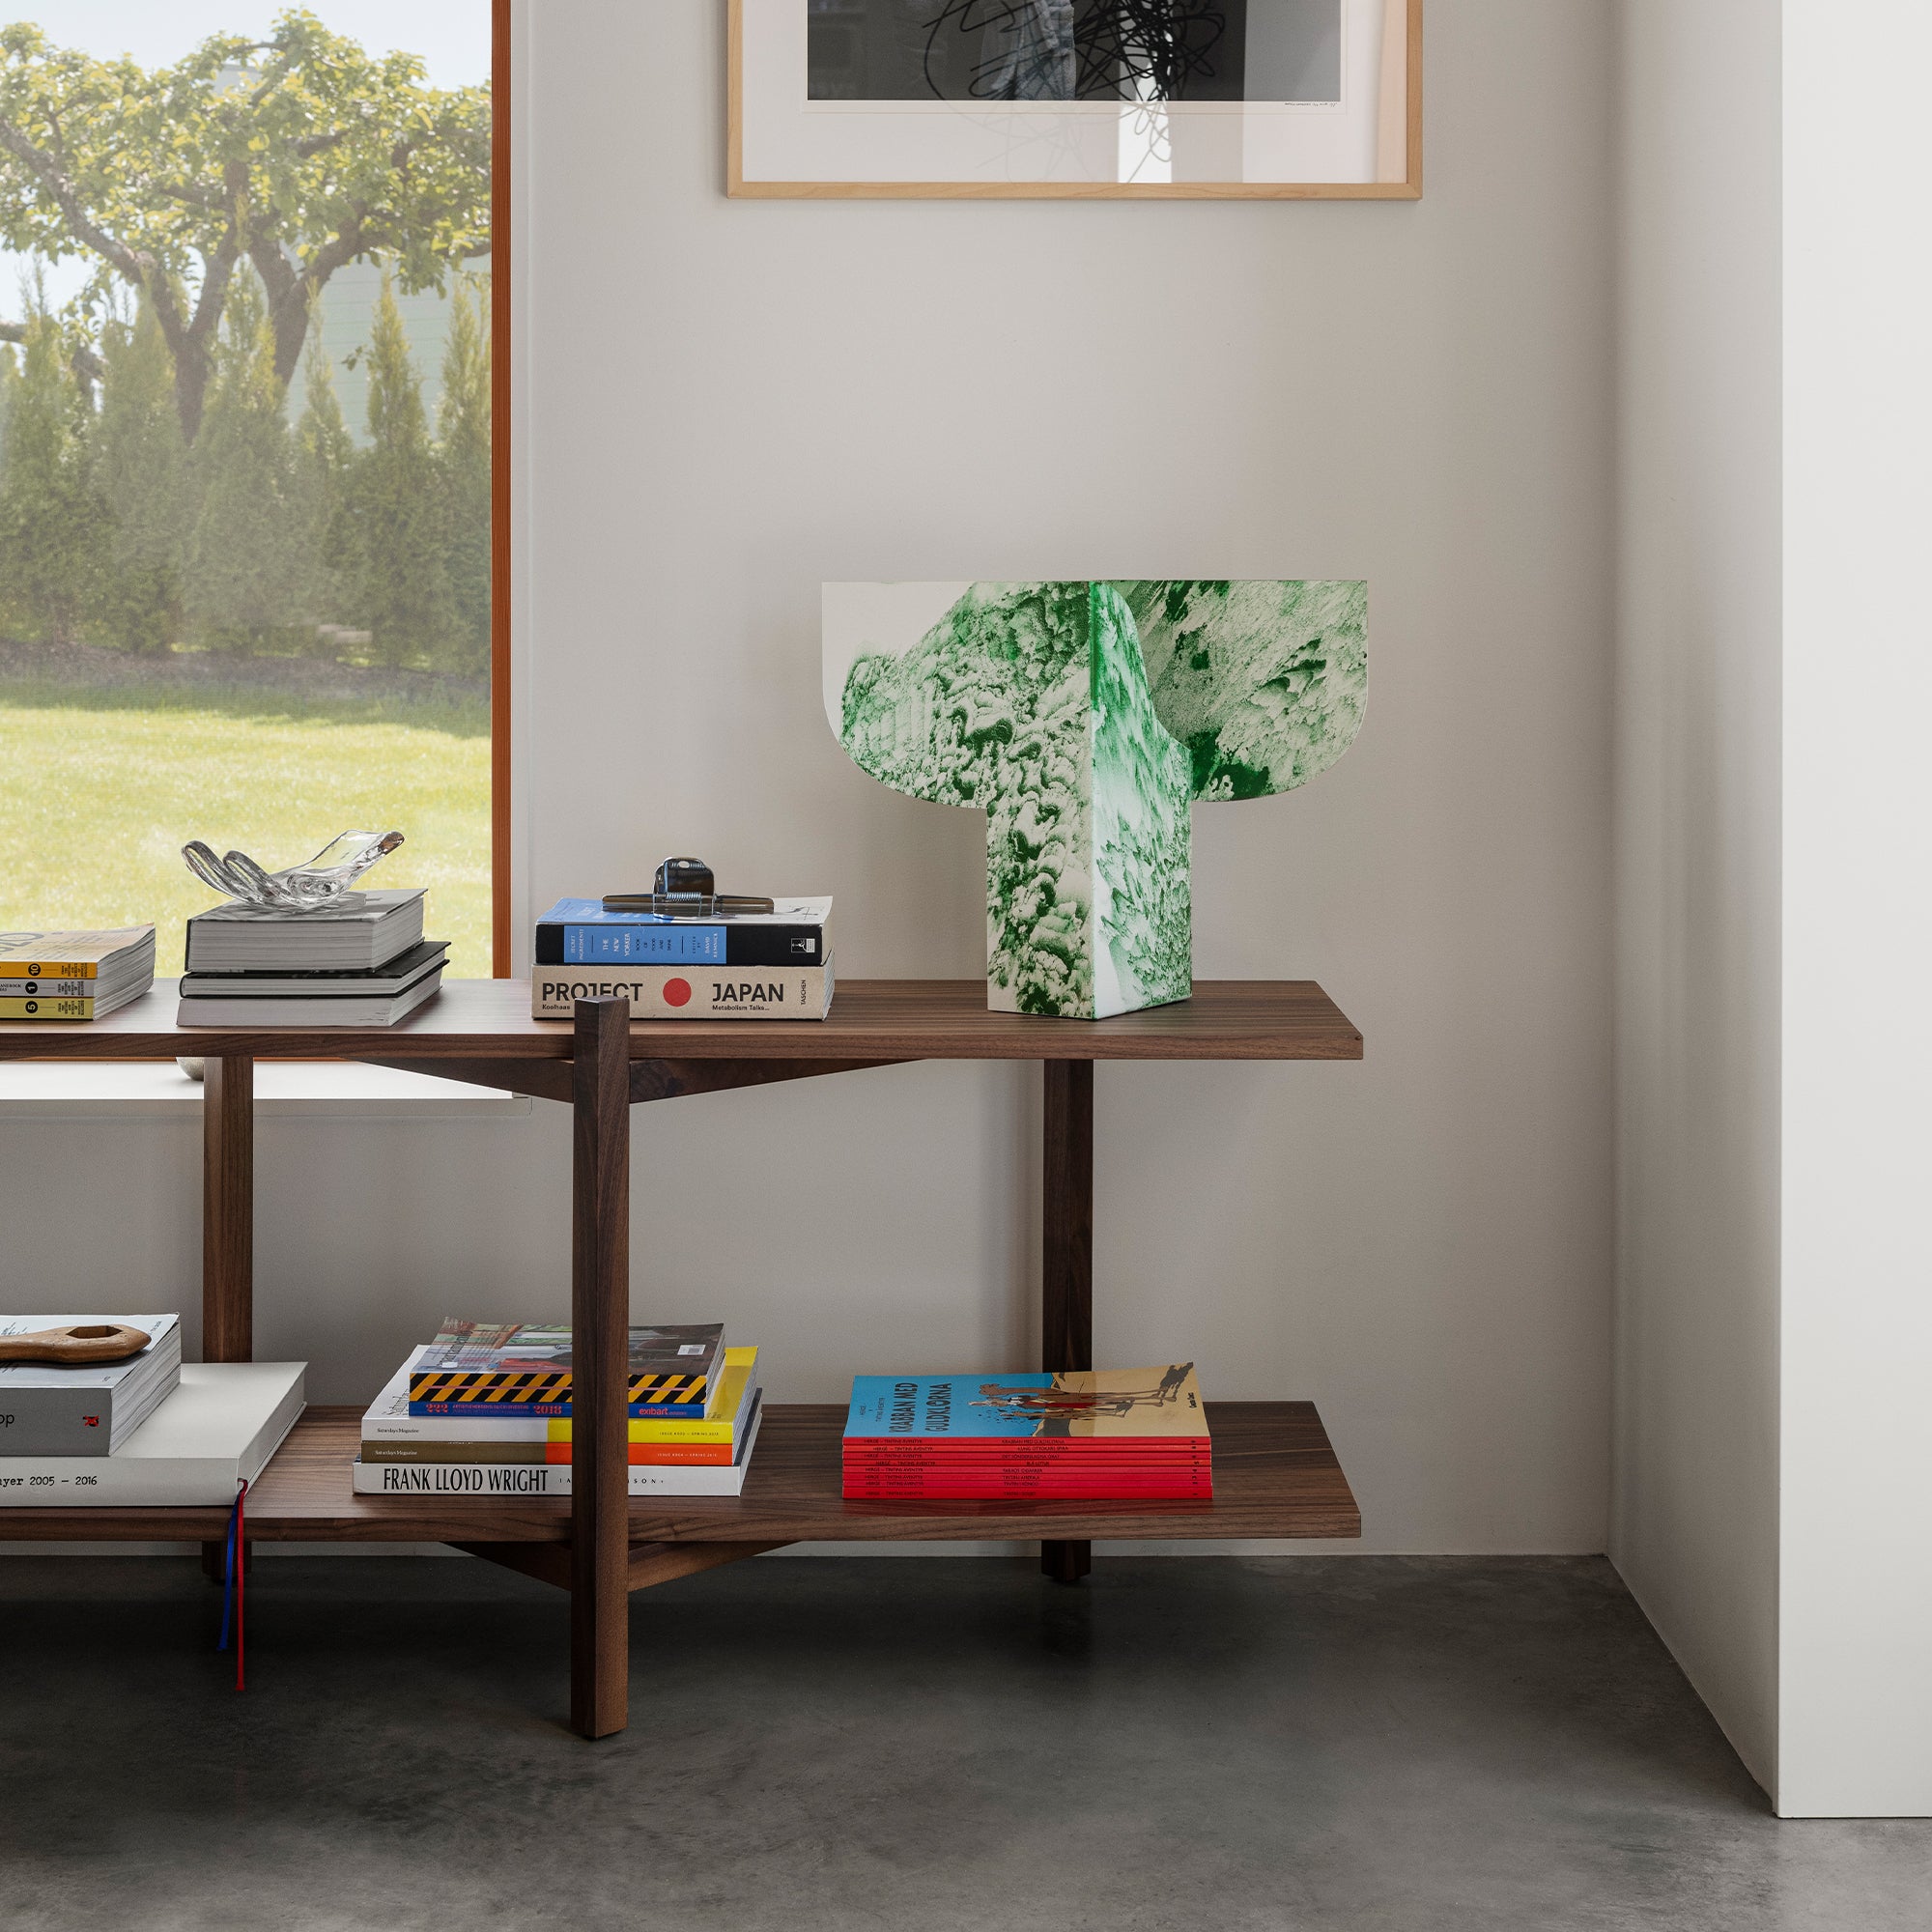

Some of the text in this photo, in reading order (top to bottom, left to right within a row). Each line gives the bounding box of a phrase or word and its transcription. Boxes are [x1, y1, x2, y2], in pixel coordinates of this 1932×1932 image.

[542, 982, 784, 1003] PROJECT JAPAN
[425, 1404, 448, 1413] 222
[639, 1406, 668, 1416] exibart
[889, 1382, 919, 1433] KRABBAN MED
[0, 1477, 24, 1488] yer
[29, 1476, 55, 1487] 2005
[75, 1475, 98, 1486] 2016
[384, 1468, 431, 1491] FRANK
[436, 1468, 483, 1491] LLOYD
[488, 1469, 549, 1492] WRIGHT
